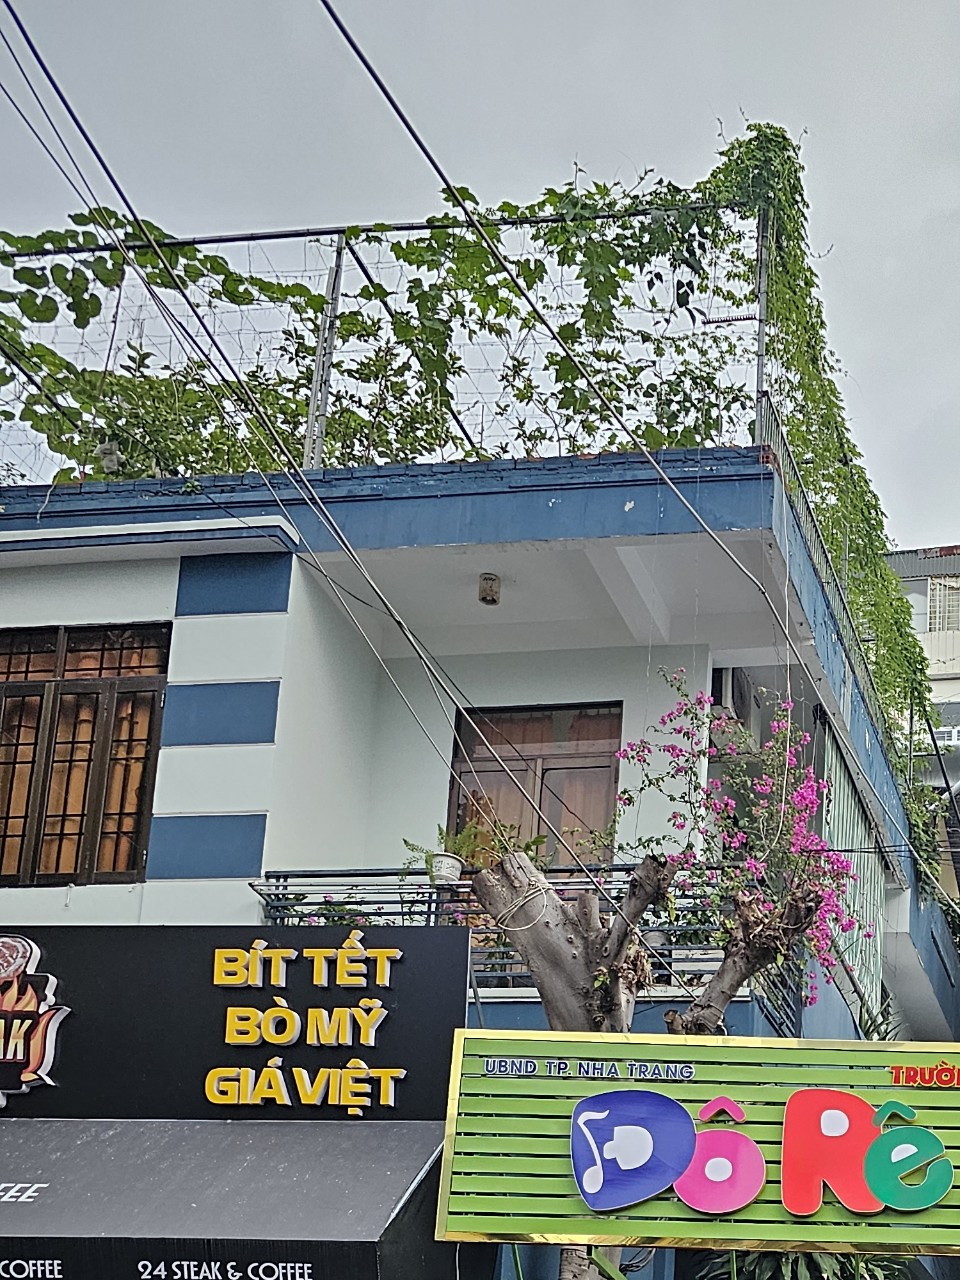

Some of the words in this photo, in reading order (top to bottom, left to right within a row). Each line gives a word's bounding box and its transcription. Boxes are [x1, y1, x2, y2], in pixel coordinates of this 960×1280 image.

[213, 939, 299, 988] BÍT
[303, 930, 403, 988] TẾT
[225, 996, 301, 1046] BÒ
[306, 998, 389, 1046] MỸ
[205, 1056, 292, 1107] GIÁ
[292, 1058, 407, 1116] VIỆT
[484, 1059, 537, 1076] UBND
[545, 1060, 573, 1077] TP.
[577, 1061, 620, 1078] NHA
[627, 1061, 695, 1080] TRANG
[781, 1087, 955, 1216] Rê
[0, 1259, 64, 1279] COFFEE
[137, 1261, 167, 1280] 24
[171, 1261, 222, 1280] STEAK
[226, 1261, 243, 1280] &
